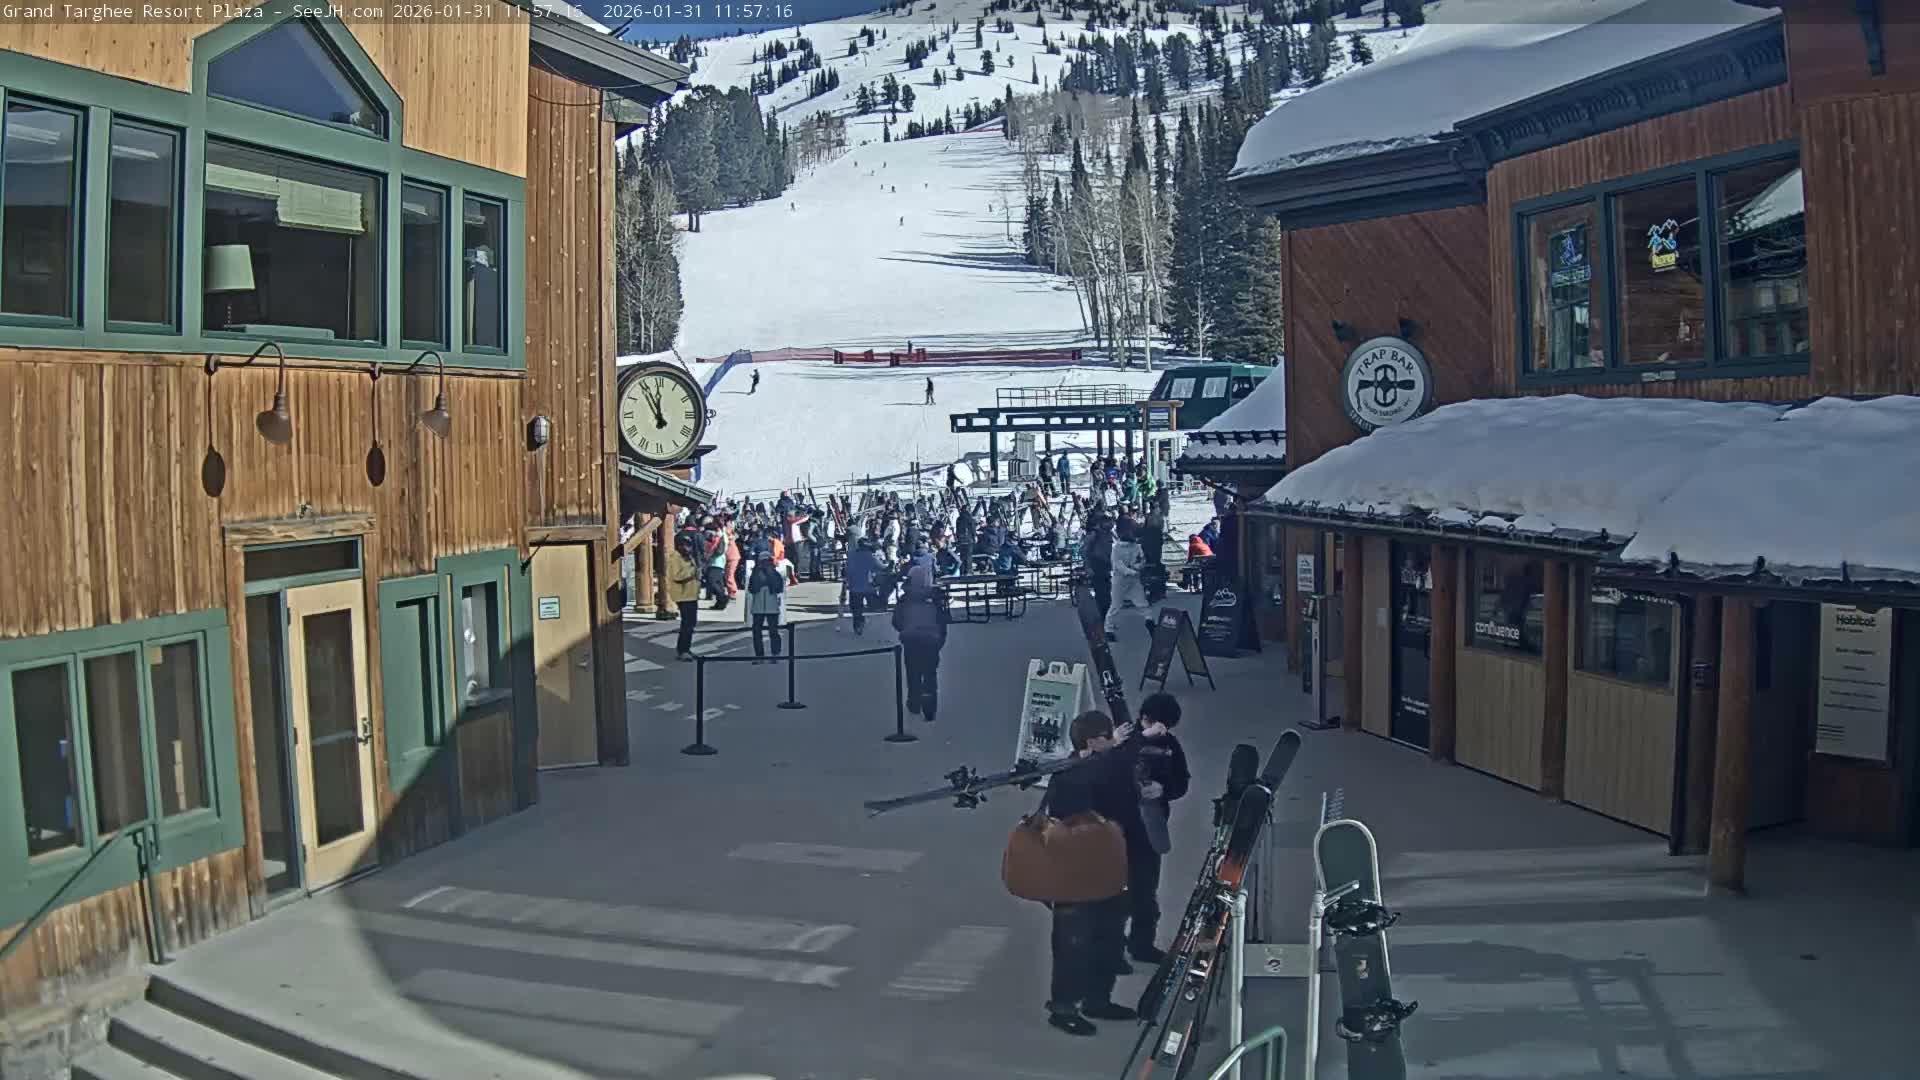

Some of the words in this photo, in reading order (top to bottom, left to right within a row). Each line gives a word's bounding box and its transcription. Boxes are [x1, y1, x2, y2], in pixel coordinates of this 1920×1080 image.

[1356, 349, 1387, 376] TRAP
[1390, 350, 1414, 375] BAR
[1836, 614, 1877, 627] Habitat
[1474, 621, 1521, 640] confluence
